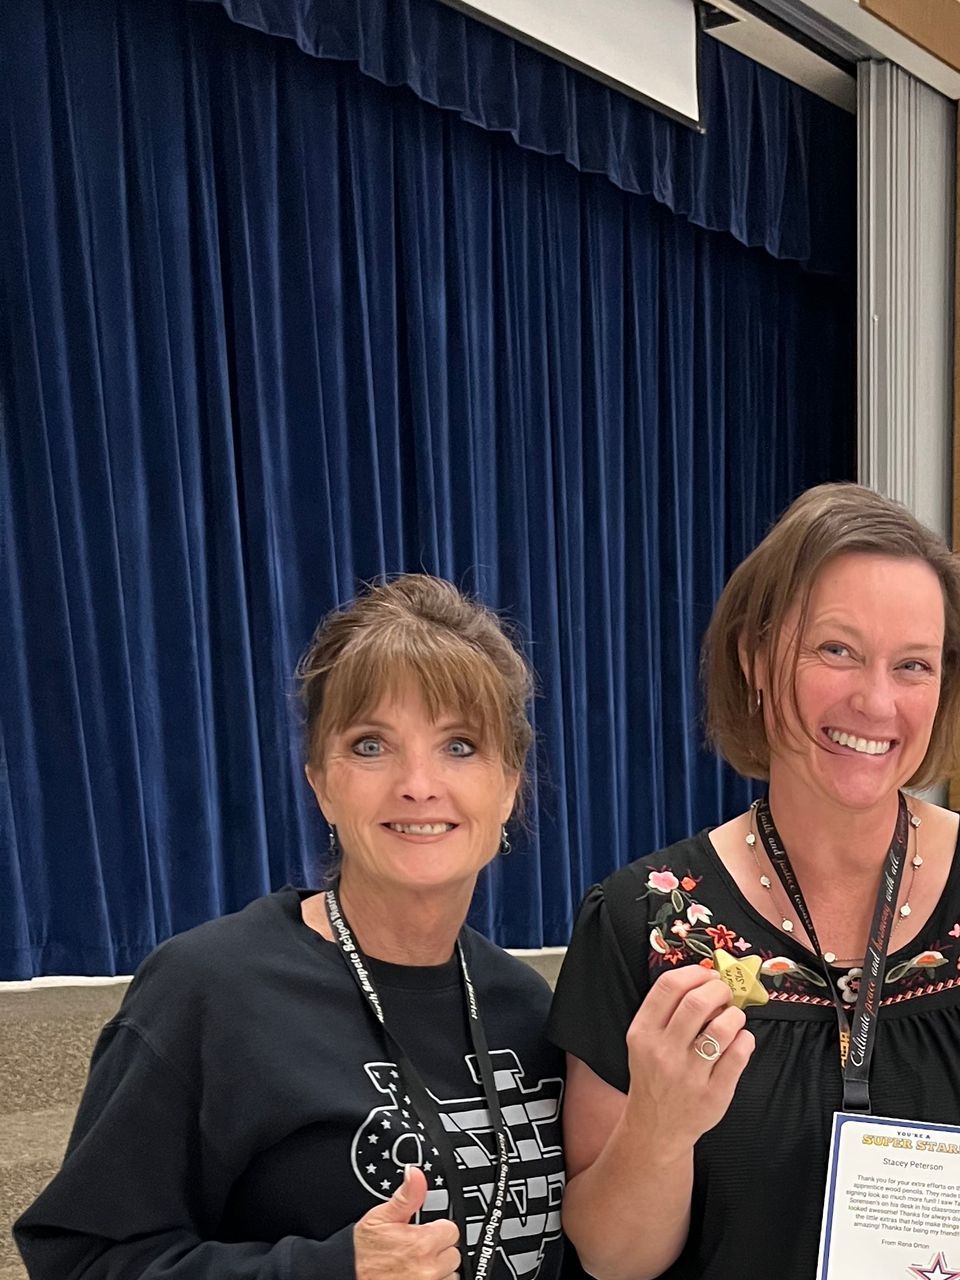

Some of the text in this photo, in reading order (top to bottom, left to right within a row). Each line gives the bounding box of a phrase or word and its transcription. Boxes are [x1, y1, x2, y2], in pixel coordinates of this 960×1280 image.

[768, 837, 785, 856] and
[885, 871, 895, 902] with
[333, 918, 355, 952] School
[872, 903, 894, 951] harmony
[350, 952, 373, 992] Sanpete
[869, 946, 881, 977] and
[865, 980, 876, 1017] peace
[850, 1013, 871, 1067] Cultivate
[862, 1134, 913, 1149] SUPER
[883, 1157, 944, 1171] Stacey Peterson
[495, 1164, 509, 1207] Sanpete
[925, 1189, 939, 1197] They
[926, 1182, 946, 1190] efforts
[484, 1208, 502, 1246] School
[881, 1223, 902, 1231] Thanks
[912, 1226, 929, 1235] being
[900, 1210, 920, 1218] Thanks
[941, 1222, 960, 1230] things
